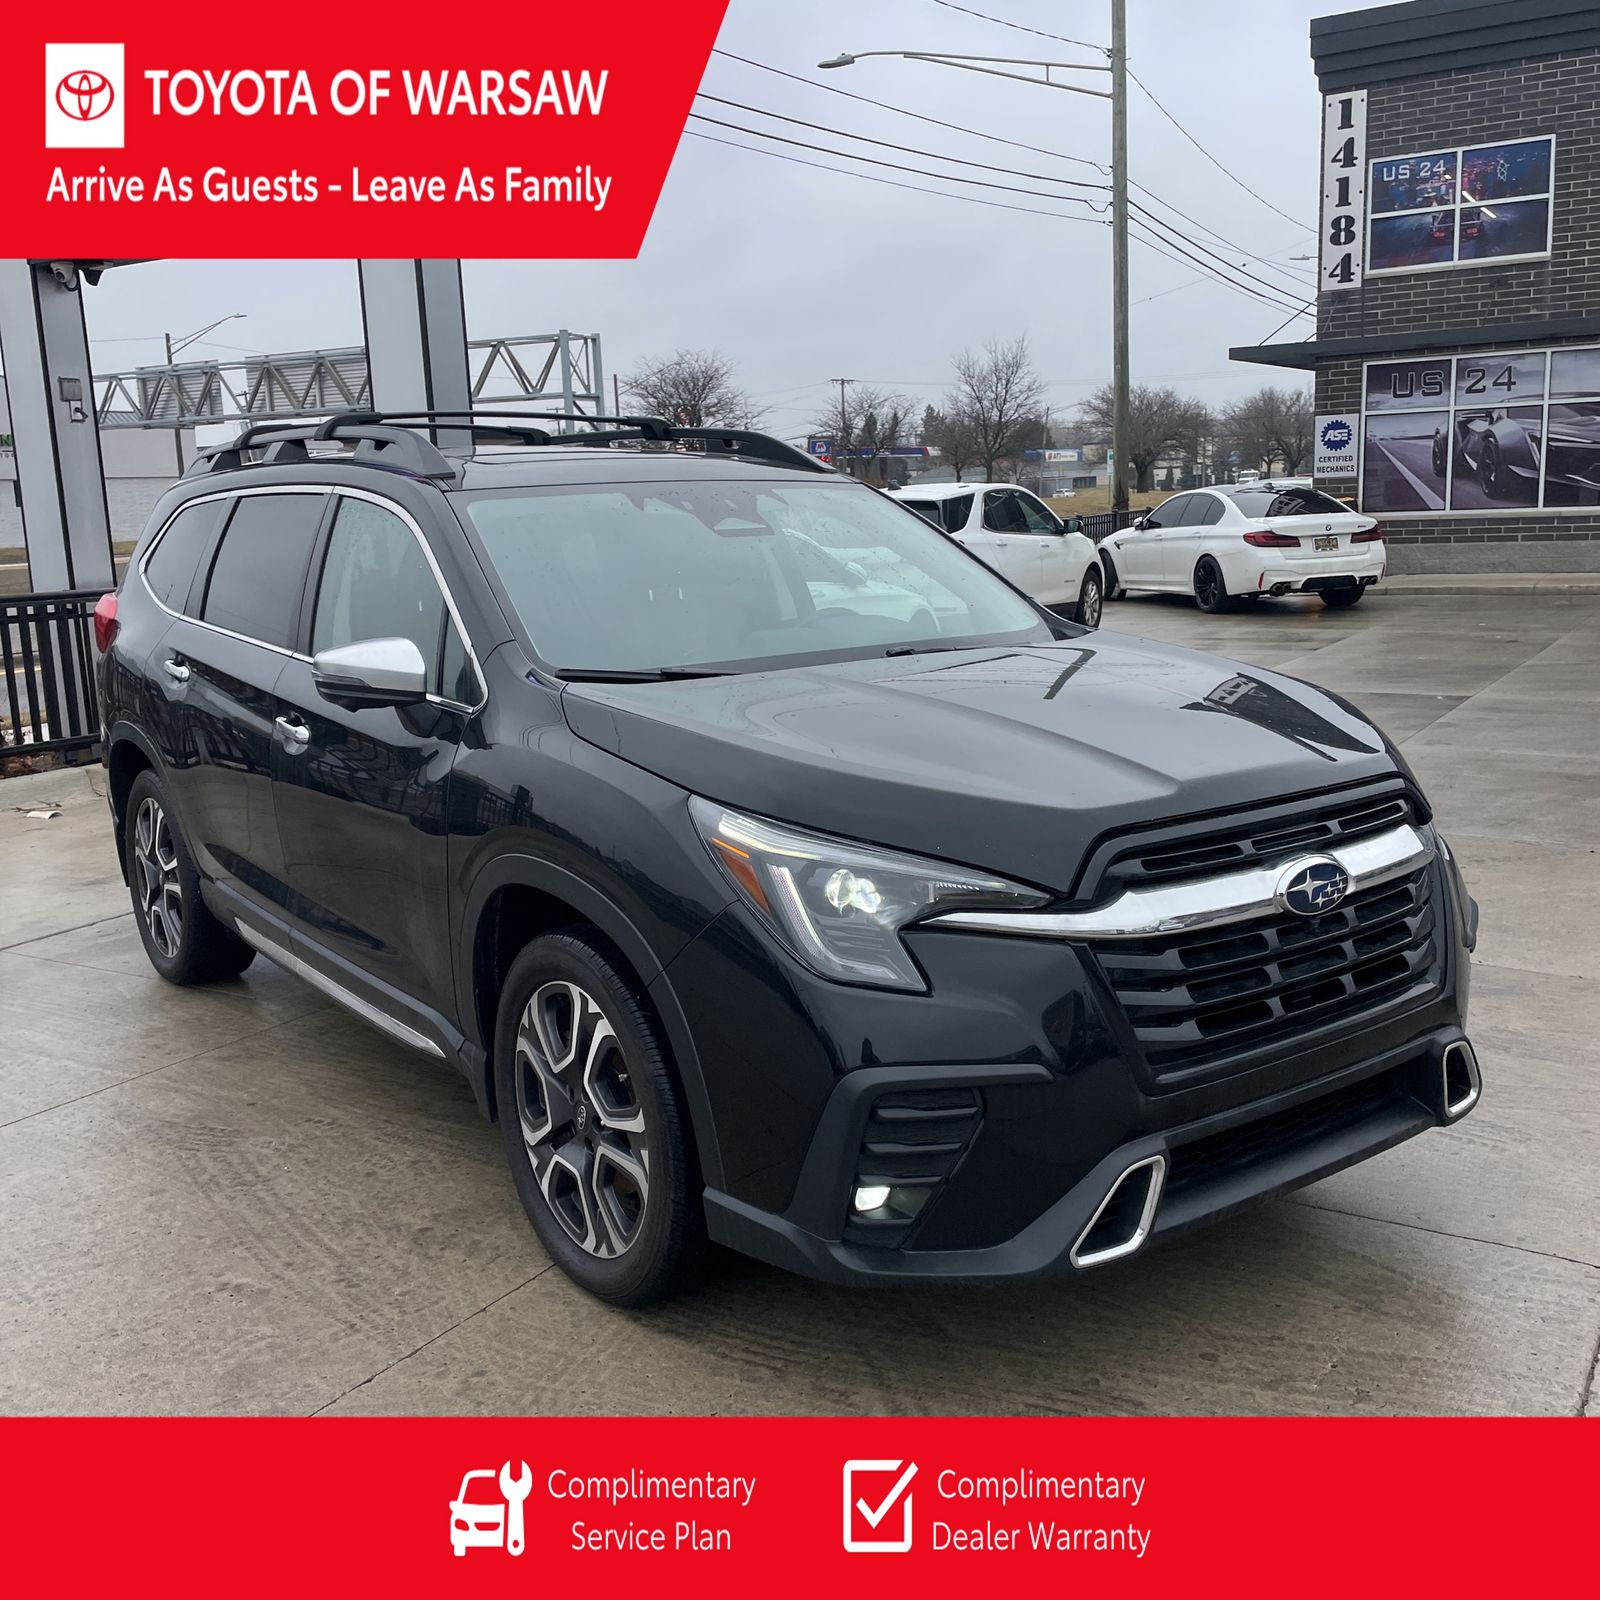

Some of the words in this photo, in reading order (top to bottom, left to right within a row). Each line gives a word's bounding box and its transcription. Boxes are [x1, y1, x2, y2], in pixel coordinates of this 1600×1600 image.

[1383, 165, 1410, 182] US
[1419, 160, 1446, 177] 24
[1326, 98, 1357, 284] 14184
[1391, 371, 1443, 399] US
[1464, 365, 1517, 395] 24
[1324, 429, 1349, 442] ASE
[1318, 455, 1354, 463] CERTIFIED
[1316, 465, 1355, 474] MECHANICS
